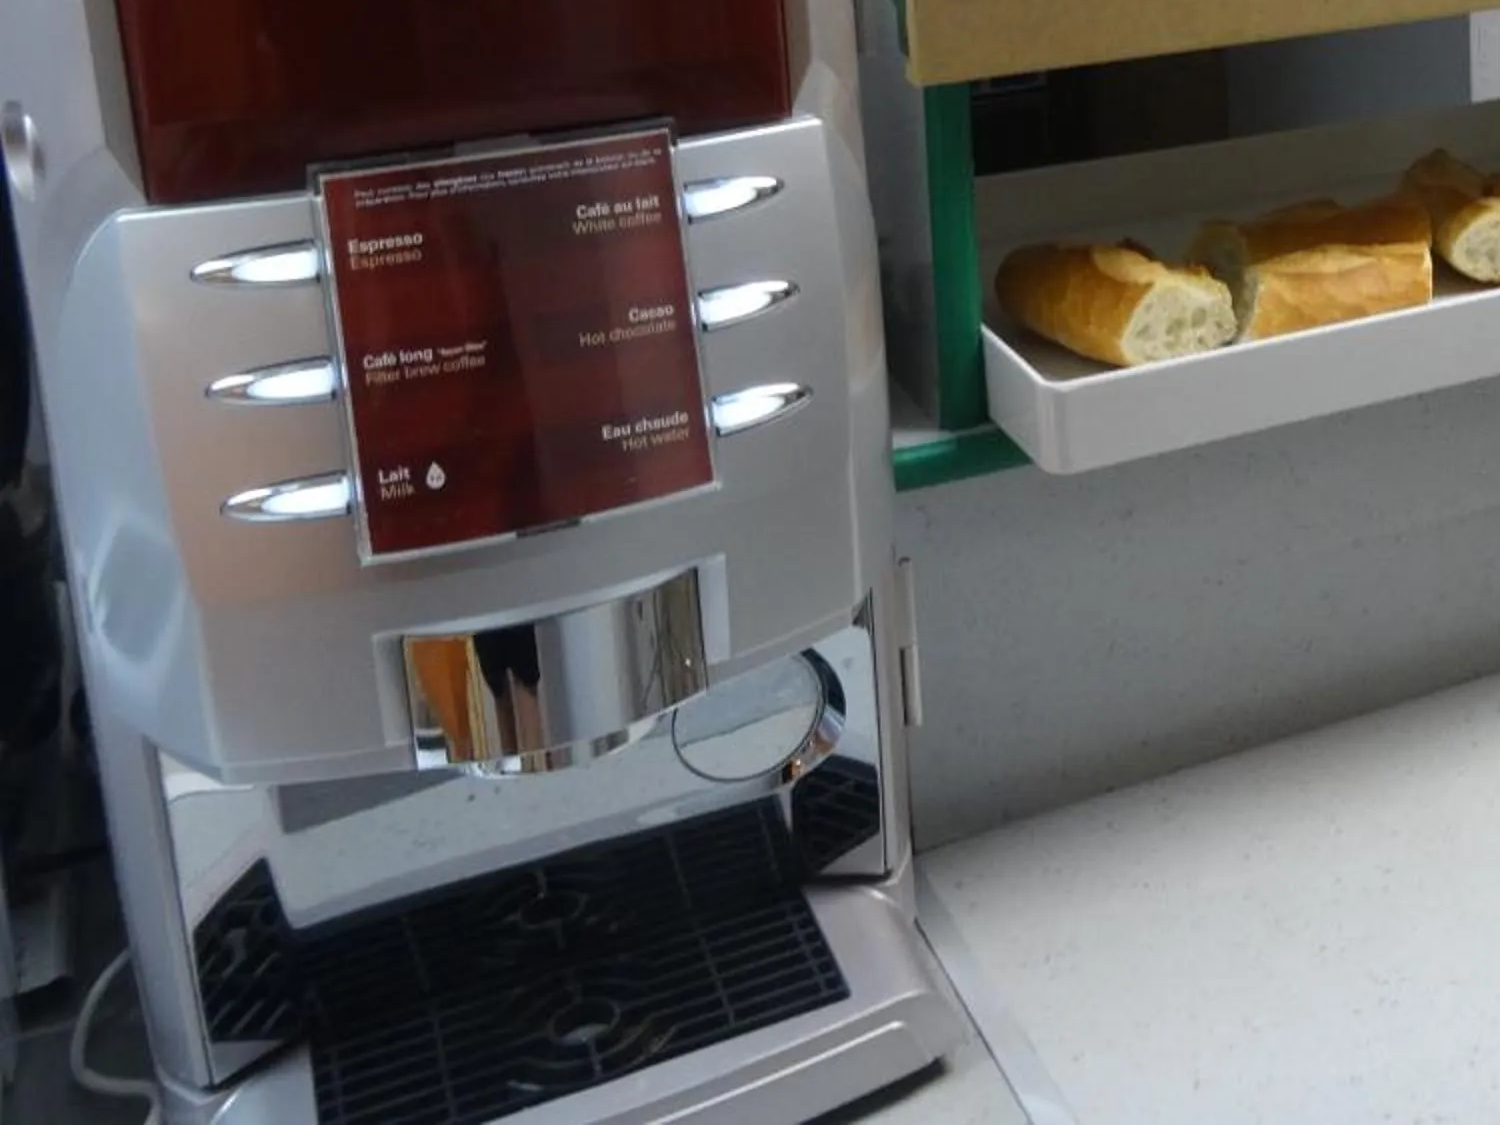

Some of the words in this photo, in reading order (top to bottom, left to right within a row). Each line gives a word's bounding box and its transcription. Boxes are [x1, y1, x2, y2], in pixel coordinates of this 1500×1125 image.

[576, 202, 610, 220] Café
[613, 202, 633, 213] au
[635, 194, 660, 210] lait
[572, 219, 616, 235] White
[618, 211, 662, 229] coffee
[348, 232, 423, 255] Espresso
[350, 249, 422, 271] Espresso
[628, 304, 675, 324] Cacao
[578, 330, 606, 348] Hot
[363, 352, 397, 370] Café
[399, 348, 433, 364] long
[365, 368, 400, 387] Filter
[403, 364, 440, 380] brew
[442, 354, 486, 373] coffee
[602, 424, 631, 441] Eau
[635, 410, 689, 434] chaude
[622, 435, 648, 453] Hot
[649, 427, 690, 448] water
[378, 464, 411, 485] Lait
[381, 481, 416, 501] Milk
